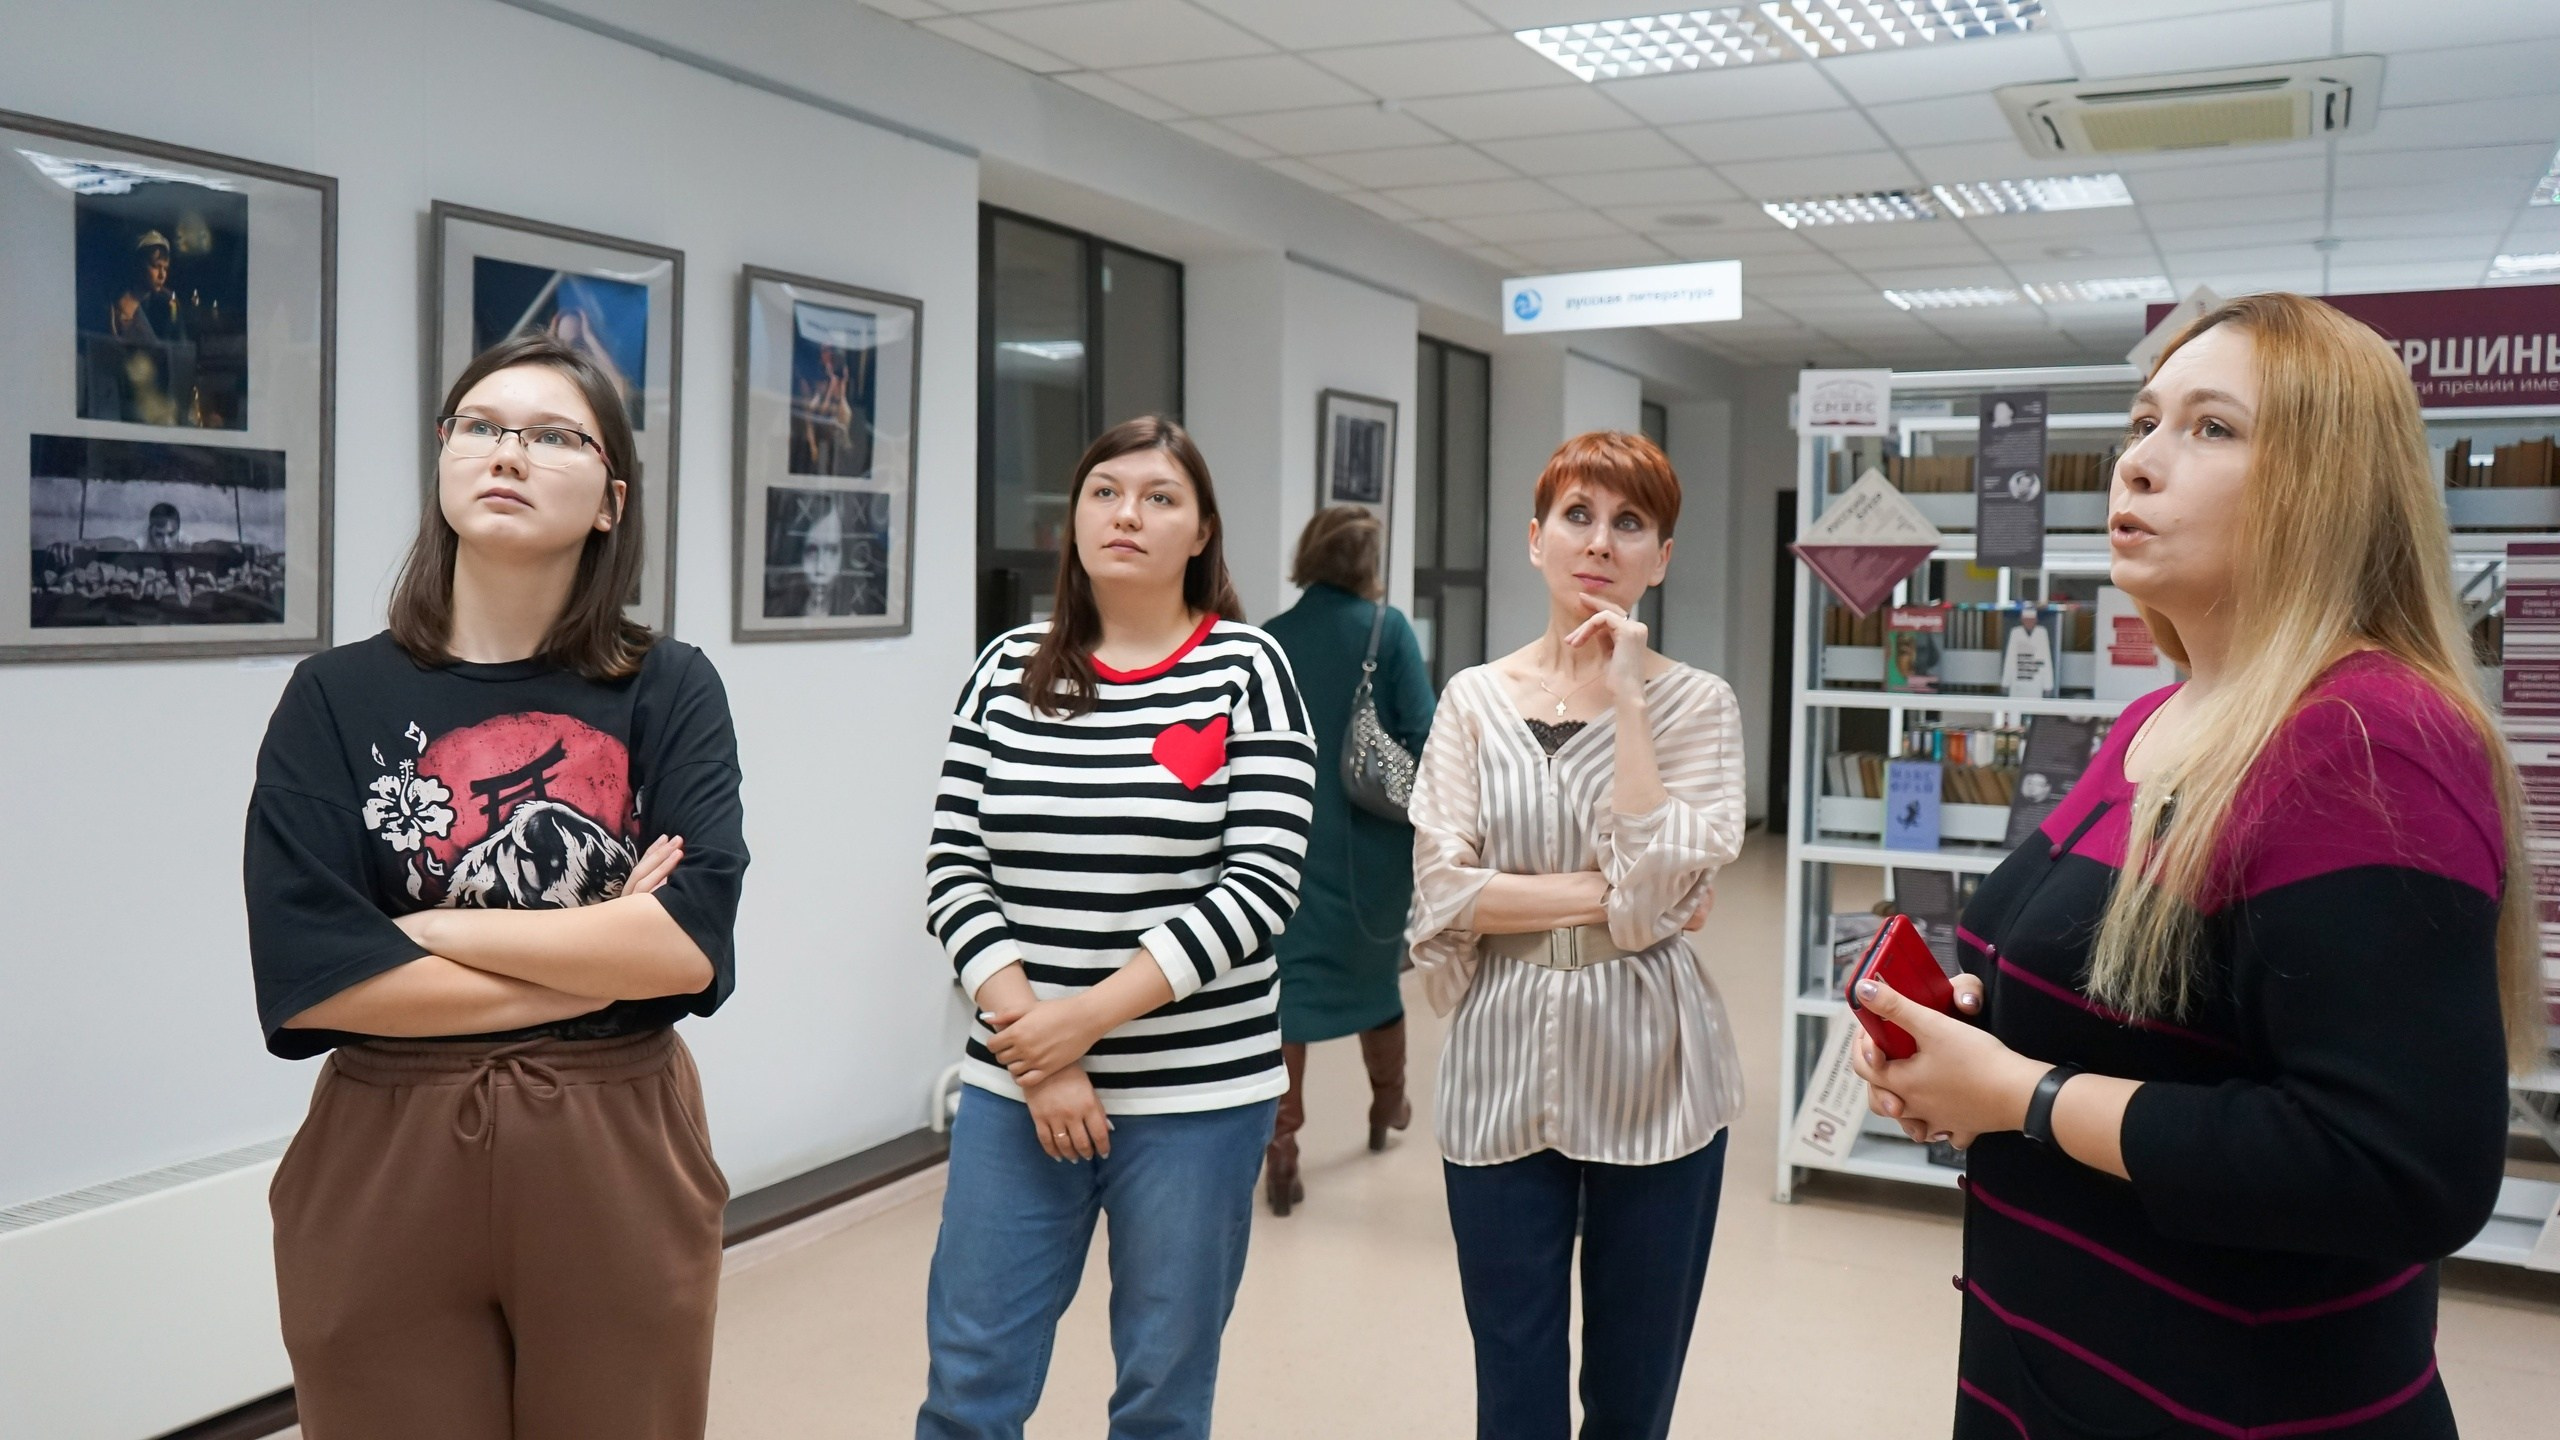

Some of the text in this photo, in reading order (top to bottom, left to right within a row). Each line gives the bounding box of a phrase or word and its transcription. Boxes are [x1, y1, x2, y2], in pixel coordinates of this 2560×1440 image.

[1565, 287, 1715, 310] русская литература
[2412, 376, 2560, 398] ти премии име
